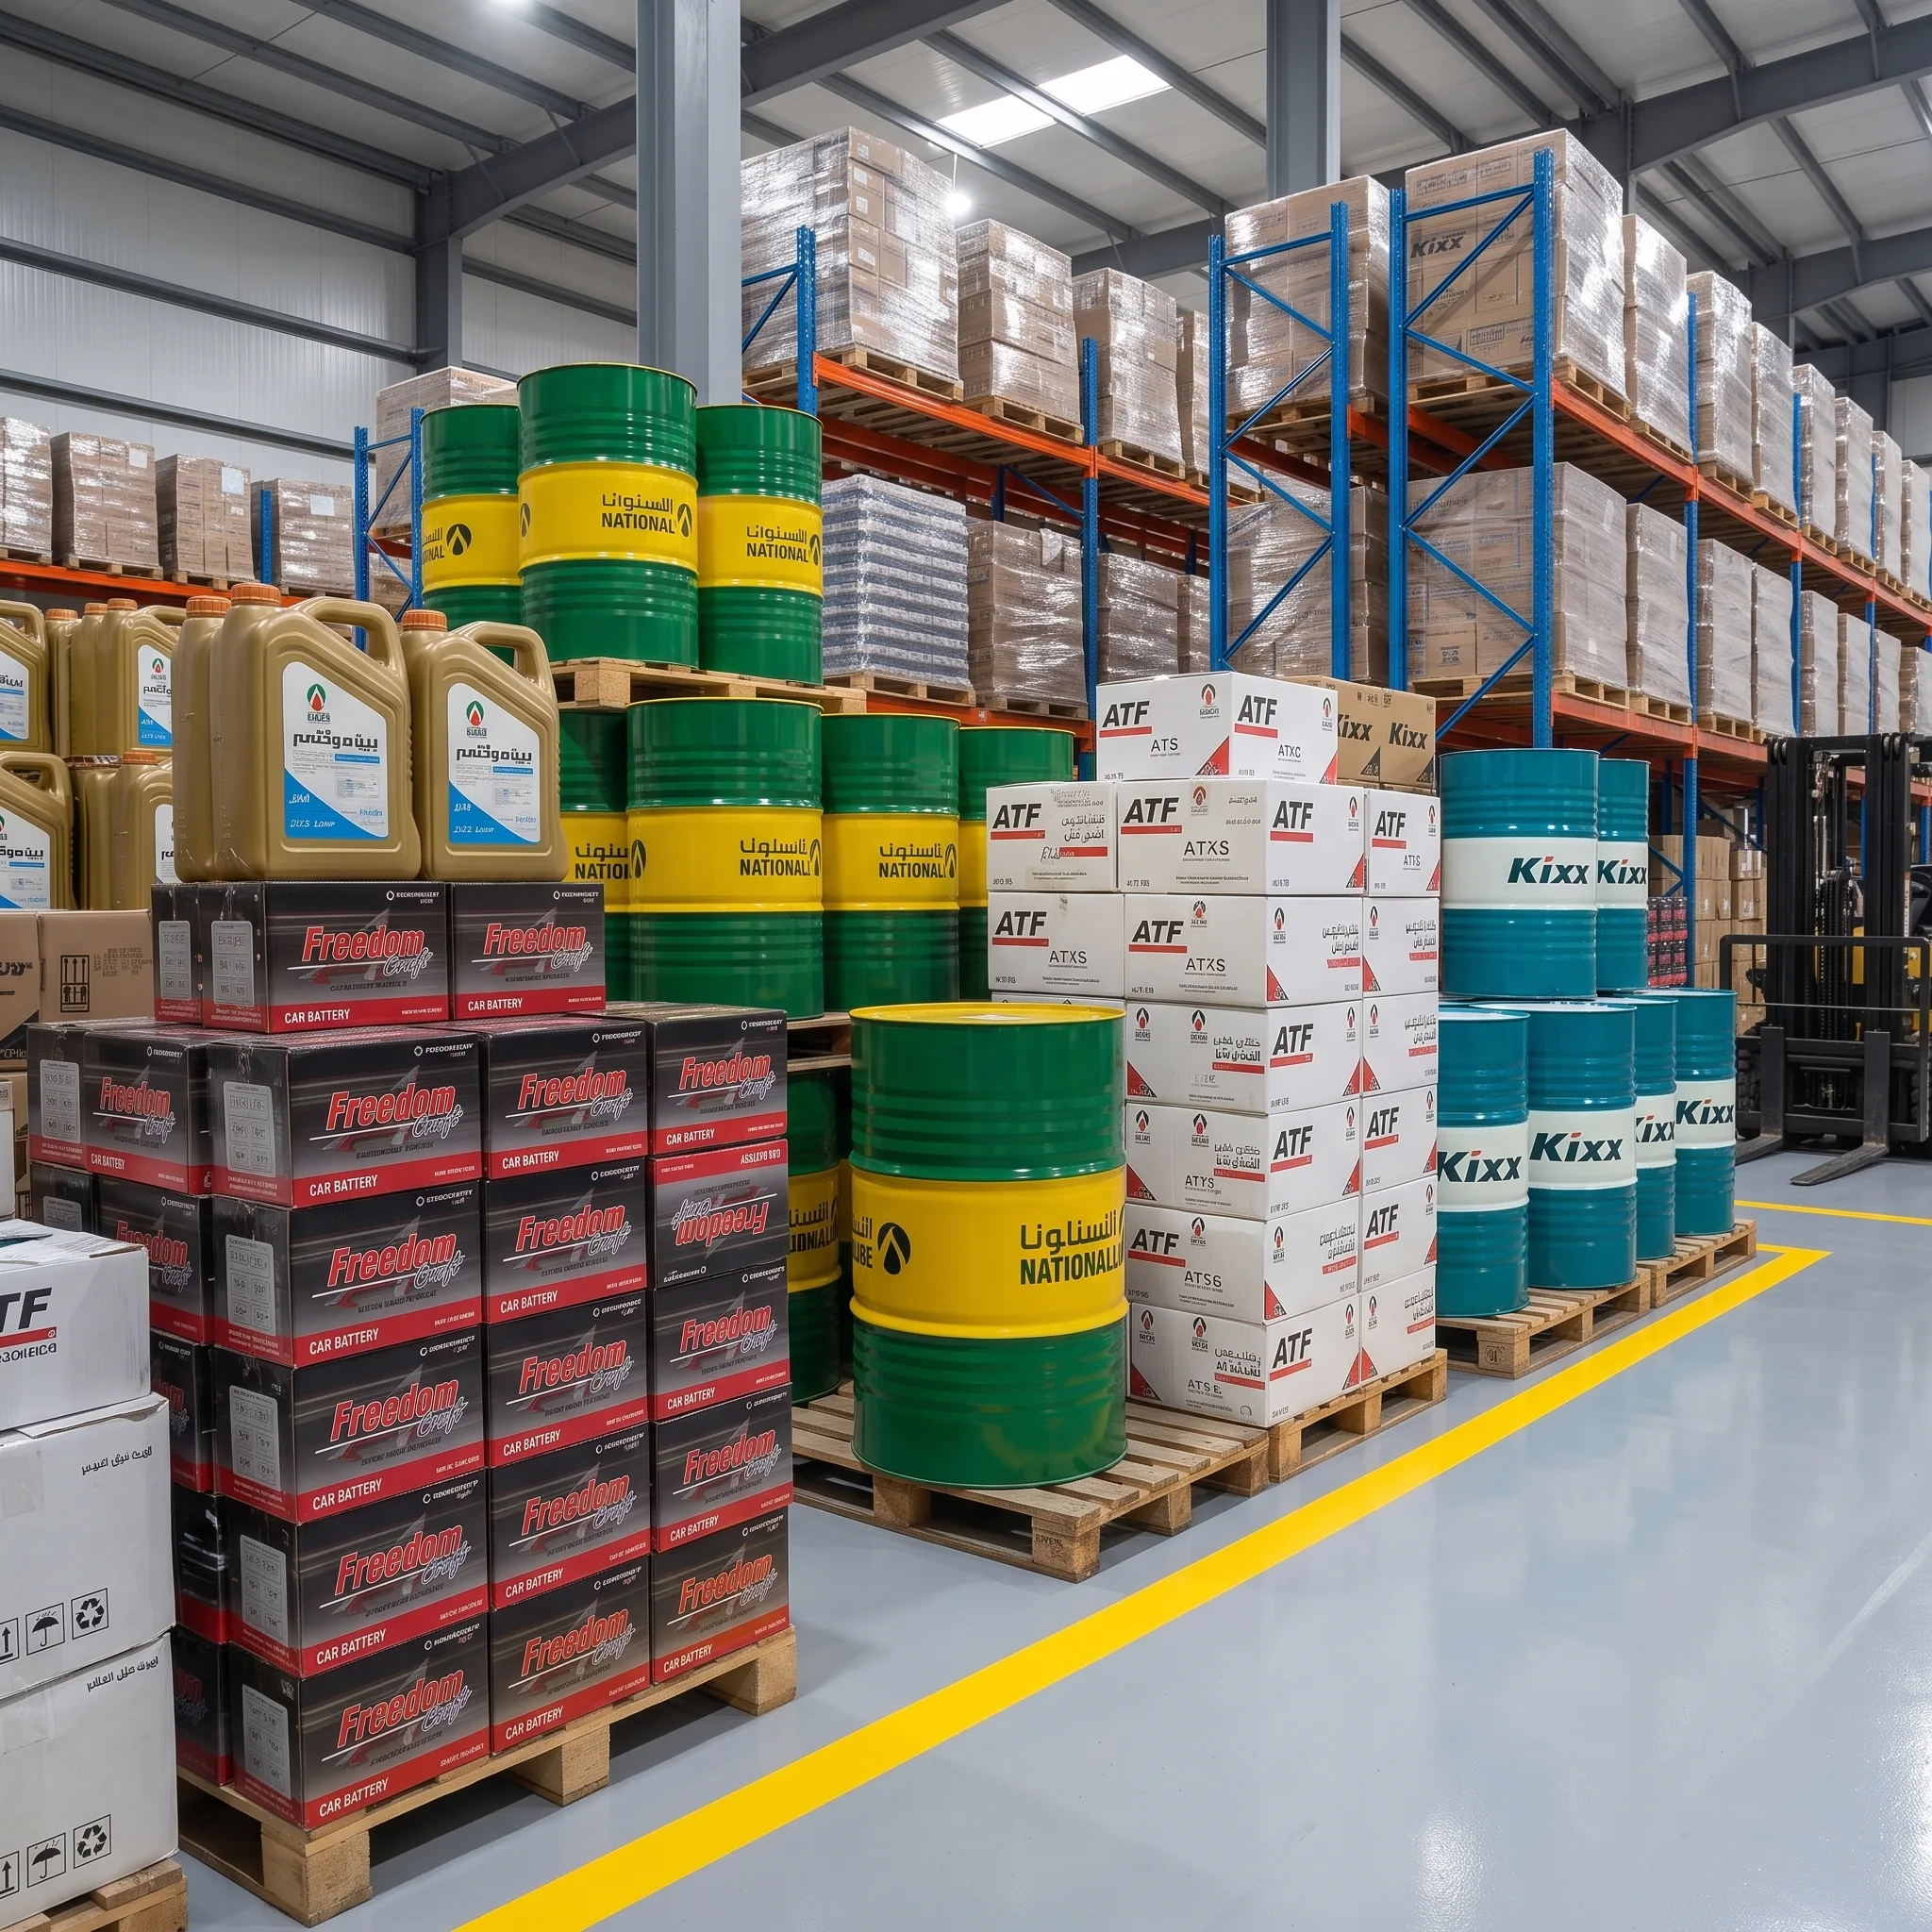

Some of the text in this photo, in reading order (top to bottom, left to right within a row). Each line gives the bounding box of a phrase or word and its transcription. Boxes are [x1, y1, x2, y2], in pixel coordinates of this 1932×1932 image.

[1410, 236, 1464, 258] Kixx
[602, 512, 675, 535] NATIONAL
[747, 542, 809, 563] NATIONAL
[1102, 700, 1150, 728] ATF
[1237, 694, 1278, 725] ATF
[1389, 723, 1428, 751] Kixx
[992, 803, 1041, 829] ATF
[1124, 797, 1179, 824] ATF
[1273, 800, 1314, 830] ATF
[1374, 810, 1407, 838] ATF
[1507, 856, 1591, 885] Kixx
[1597, 858, 1647, 885] Kixx
[994, 910, 1048, 936] ATF
[1132, 920, 1184, 943] ATF
[302, 924, 425, 961] Freedom
[483, 923, 586, 955] Freedom
[1049, 951, 1087, 964] ATXS
[1185, 958, 1226, 973] ATXS
[284, 1008, 351, 1024] CAR BATTERY
[468, 997, 523, 1011] CAR BATTERY
[1272, 1023, 1314, 1056] ATF
[679, 1052, 772, 1091] Freedom
[99, 1075, 172, 1115] Freedom
[518, 1067, 626, 1109] Freedom
[325, 1082, 457, 1131] Freedom
[1676, 1099, 1734, 1125] Kixx
[666, 1128, 715, 1145] CAR BATTERY
[1366, 1107, 1400, 1139] ATF
[1273, 1124, 1313, 1161] ATF
[1529, 1132, 1623, 1162] Kixx
[502, 1151, 560, 1170] CAR BATTERY
[1438, 1150, 1523, 1182] Kixx
[309, 1174, 378, 1197] CAR BATTERY
[515, 1204, 625, 1253] Freedom
[1366, 1204, 1399, 1239] ATF
[1130, 1228, 1179, 1256] ATF
[327, 1232, 458, 1287] Freedom
[500, 1291, 558, 1314] CAR BATTERY
[309, 1329, 378, 1356] CAR BATTERY
[679, 1305, 772, 1354] Freedom
[1272, 1327, 1313, 1369] ATF
[519, 1340, 626, 1395] Freedom
[330, 1378, 459, 1442] Freedom
[667, 1387, 716, 1410] CAR BATTERY
[503, 1429, 561, 1457] CAR BATTERY
[683, 1429, 776, 1486] Freedom
[312, 1477, 383, 1510] CAR BATTERY
[521, 1474, 630, 1536] Freedom
[670, 1514, 720, 1541] CAR BATTERY
[335, 1524, 463, 1597] Freedom
[505, 1568, 564, 1598] CAR BATTERY
[678, 1554, 773, 1615] Freedom
[316, 1629, 387, 1665] CAR BATTERY
[521, 1608, 629, 1677] Freedom
[663, 1644, 713, 1673] CAR BATTERY
[337, 1669, 464, 1748] Freedom
[505, 1706, 564, 1740] CAR BATTERY
[319, 1776, 390, 1818] CAR BATTERY
